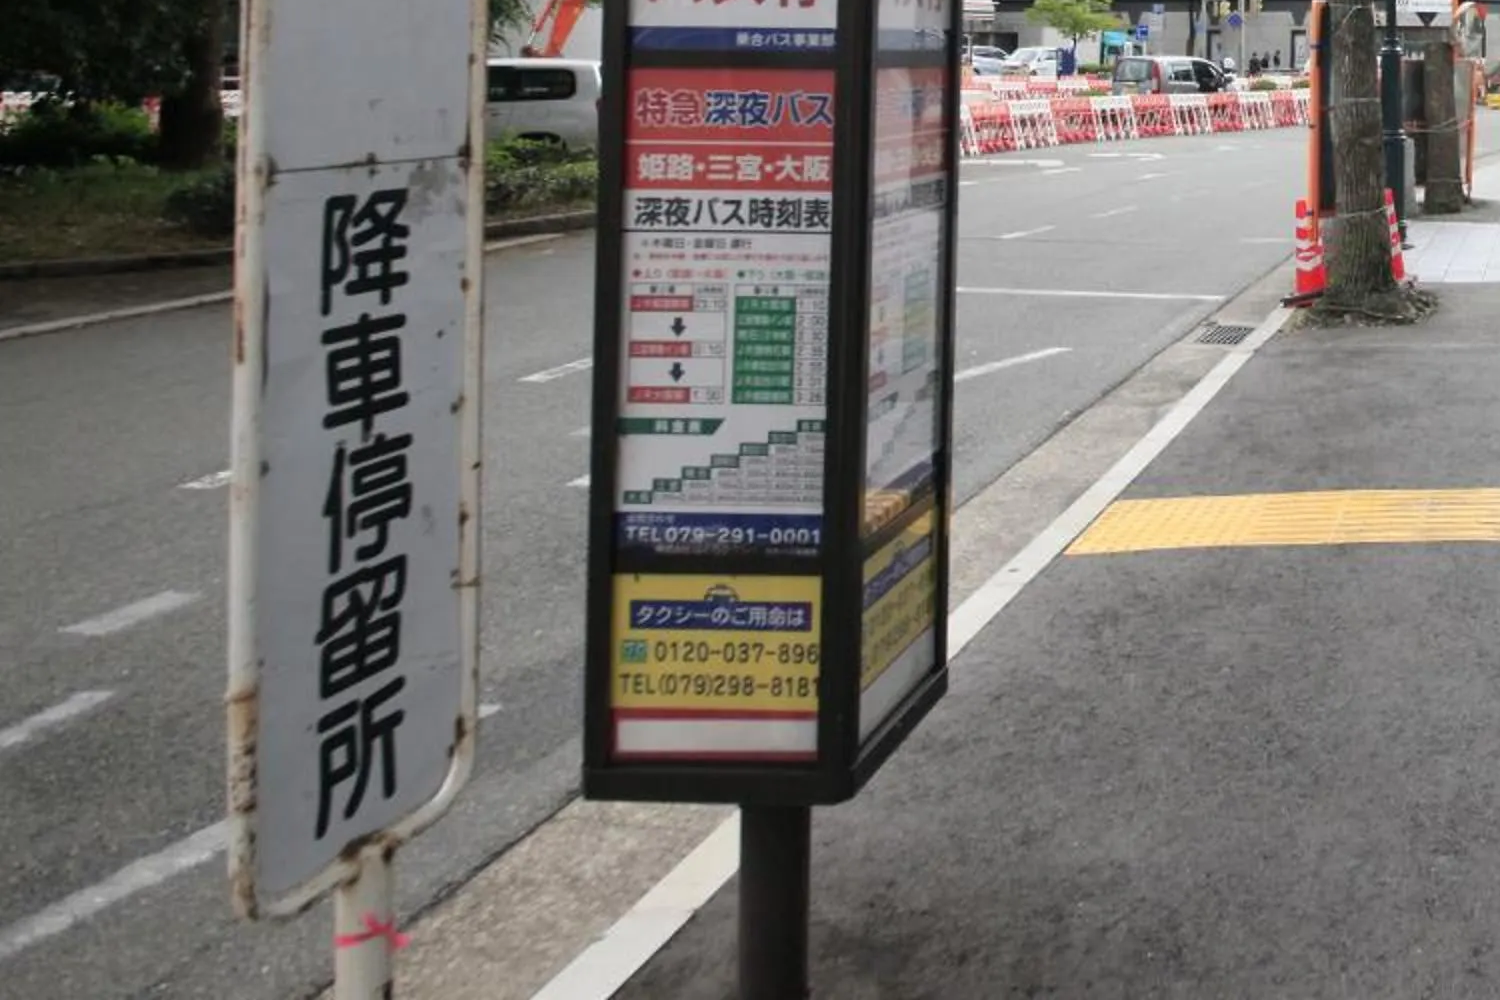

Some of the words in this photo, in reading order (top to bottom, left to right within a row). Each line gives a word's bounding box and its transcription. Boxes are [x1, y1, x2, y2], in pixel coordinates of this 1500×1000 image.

[635, 88, 834, 127] 特急深夜バス
[638, 153, 832, 182] 姫路・三宮・大阪
[634, 196, 831, 229] 深夜バス時刻表
[314, 187, 413, 842] 降車停留所
[636, 605, 805, 628] タクシーのご用命は
[654, 641, 820, 665] 0120-037-896
